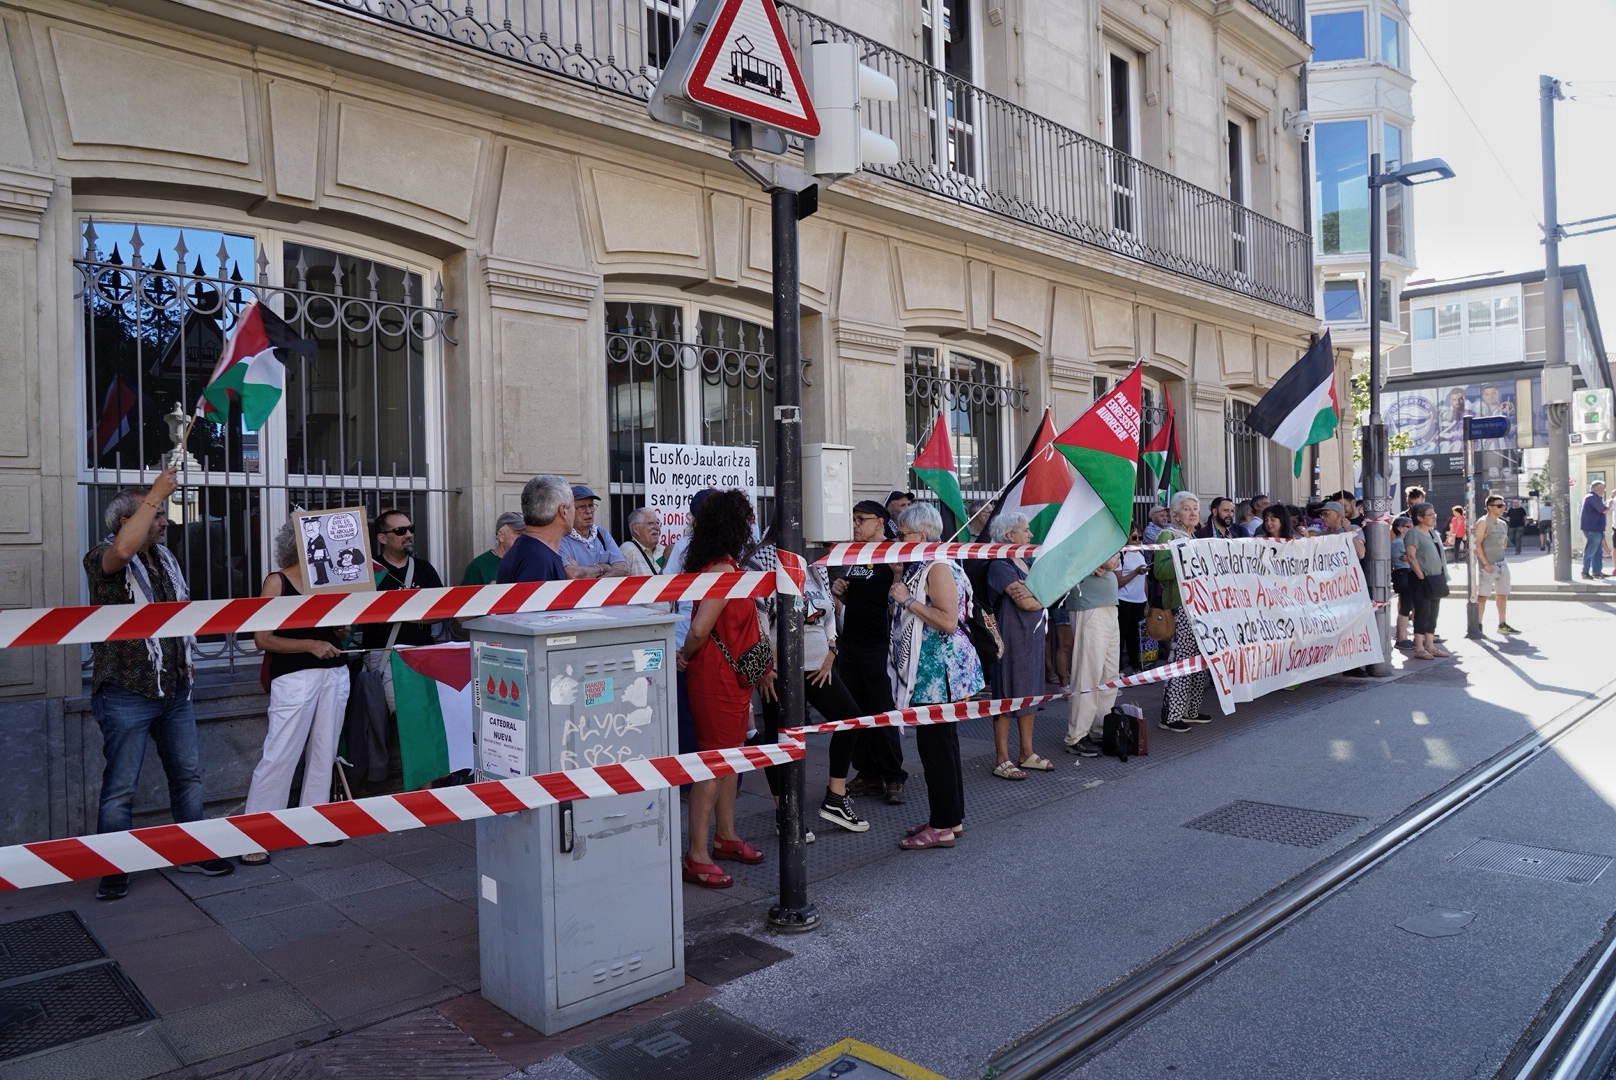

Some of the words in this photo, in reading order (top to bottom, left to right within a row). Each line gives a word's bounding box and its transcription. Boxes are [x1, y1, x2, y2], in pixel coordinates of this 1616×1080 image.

[1390, 398, 1432, 413] DEPORTIVO
[1095, 406, 1130, 442] AURRERA!
[650, 467, 666, 485] No
[672, 473, 718, 489] negocies
[722, 474, 740, 487] con
[745, 470, 754, 487] la
[651, 494, 693, 509] sangre
[489, 717, 517, 731] CATEDRAL
[493, 731, 513, 743] NUEVA
